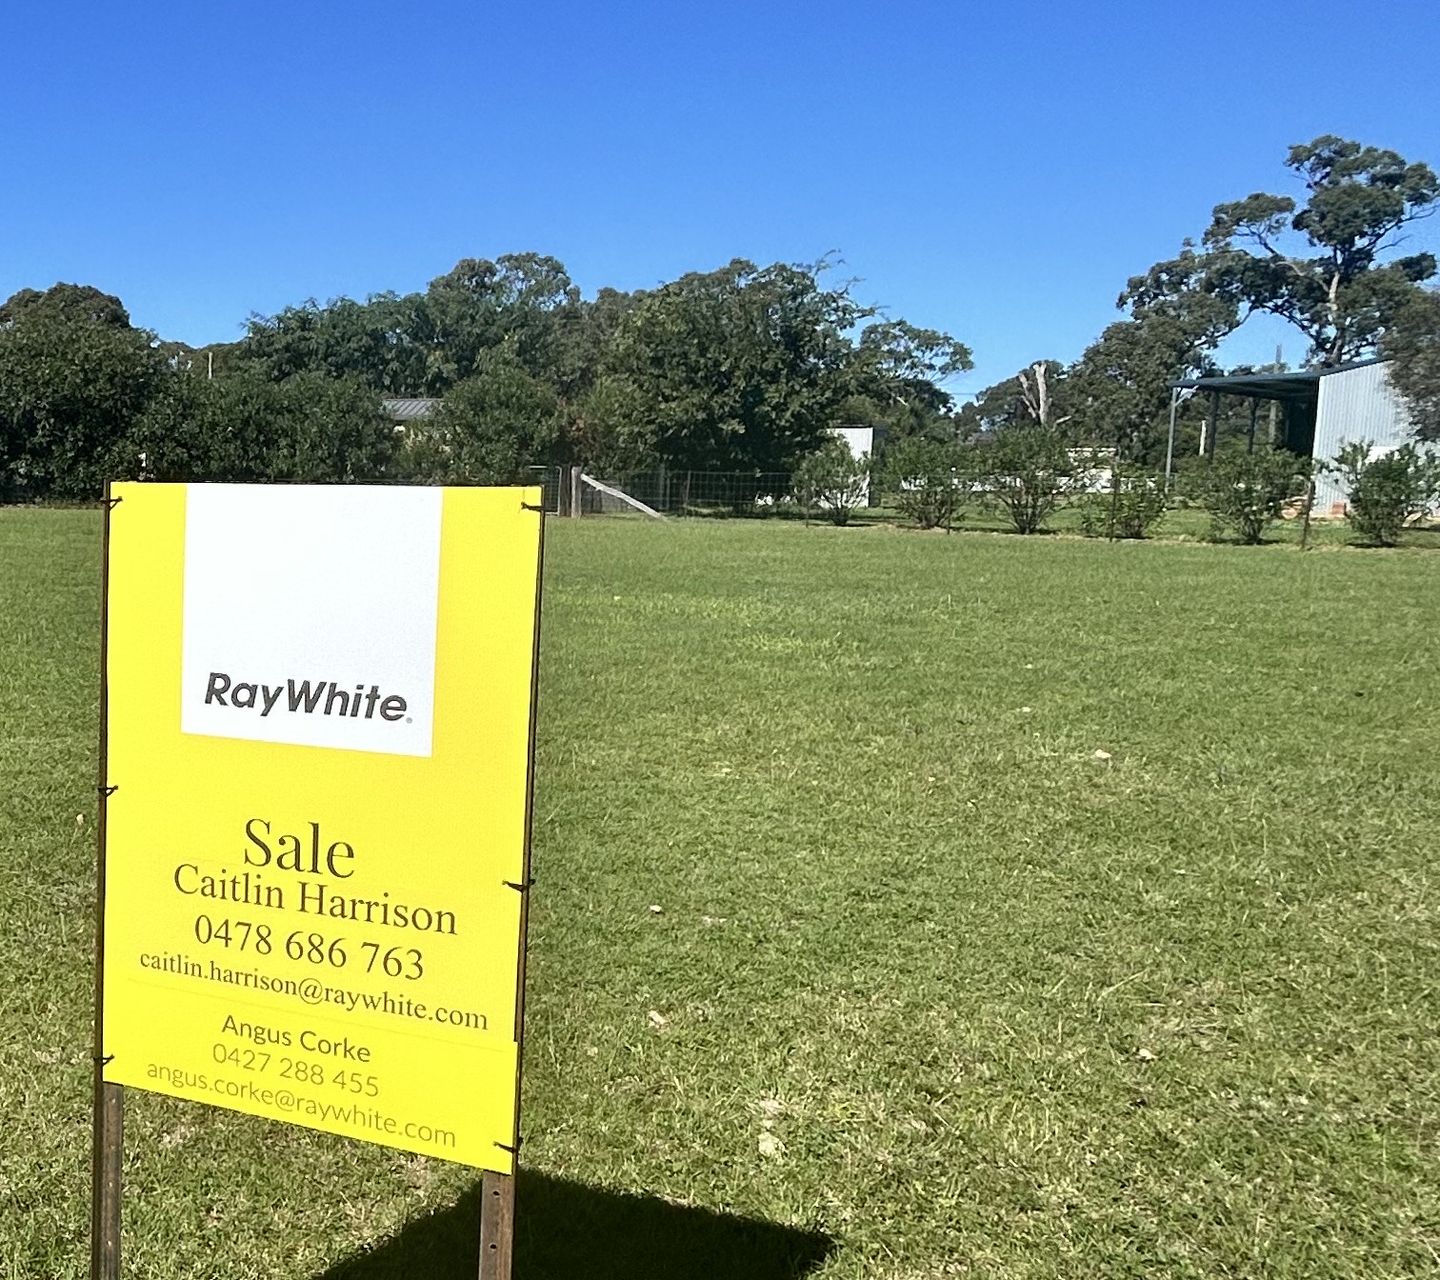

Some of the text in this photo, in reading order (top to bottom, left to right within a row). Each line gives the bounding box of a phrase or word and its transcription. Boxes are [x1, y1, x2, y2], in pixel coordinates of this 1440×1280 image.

[244, 818, 355, 878] Sale
[174, 863, 458, 935] Caitlin Harrison
[194, 914, 424, 981] 0478 686 763
[140, 950, 489, 1031] caitlin.harrison@raywhite.com
[212, 1043, 380, 1098] 0427 288 455
[221, 1014, 371, 1063] Angus Corke
[146, 1062, 457, 1148] angus.corke@raywhite.com
